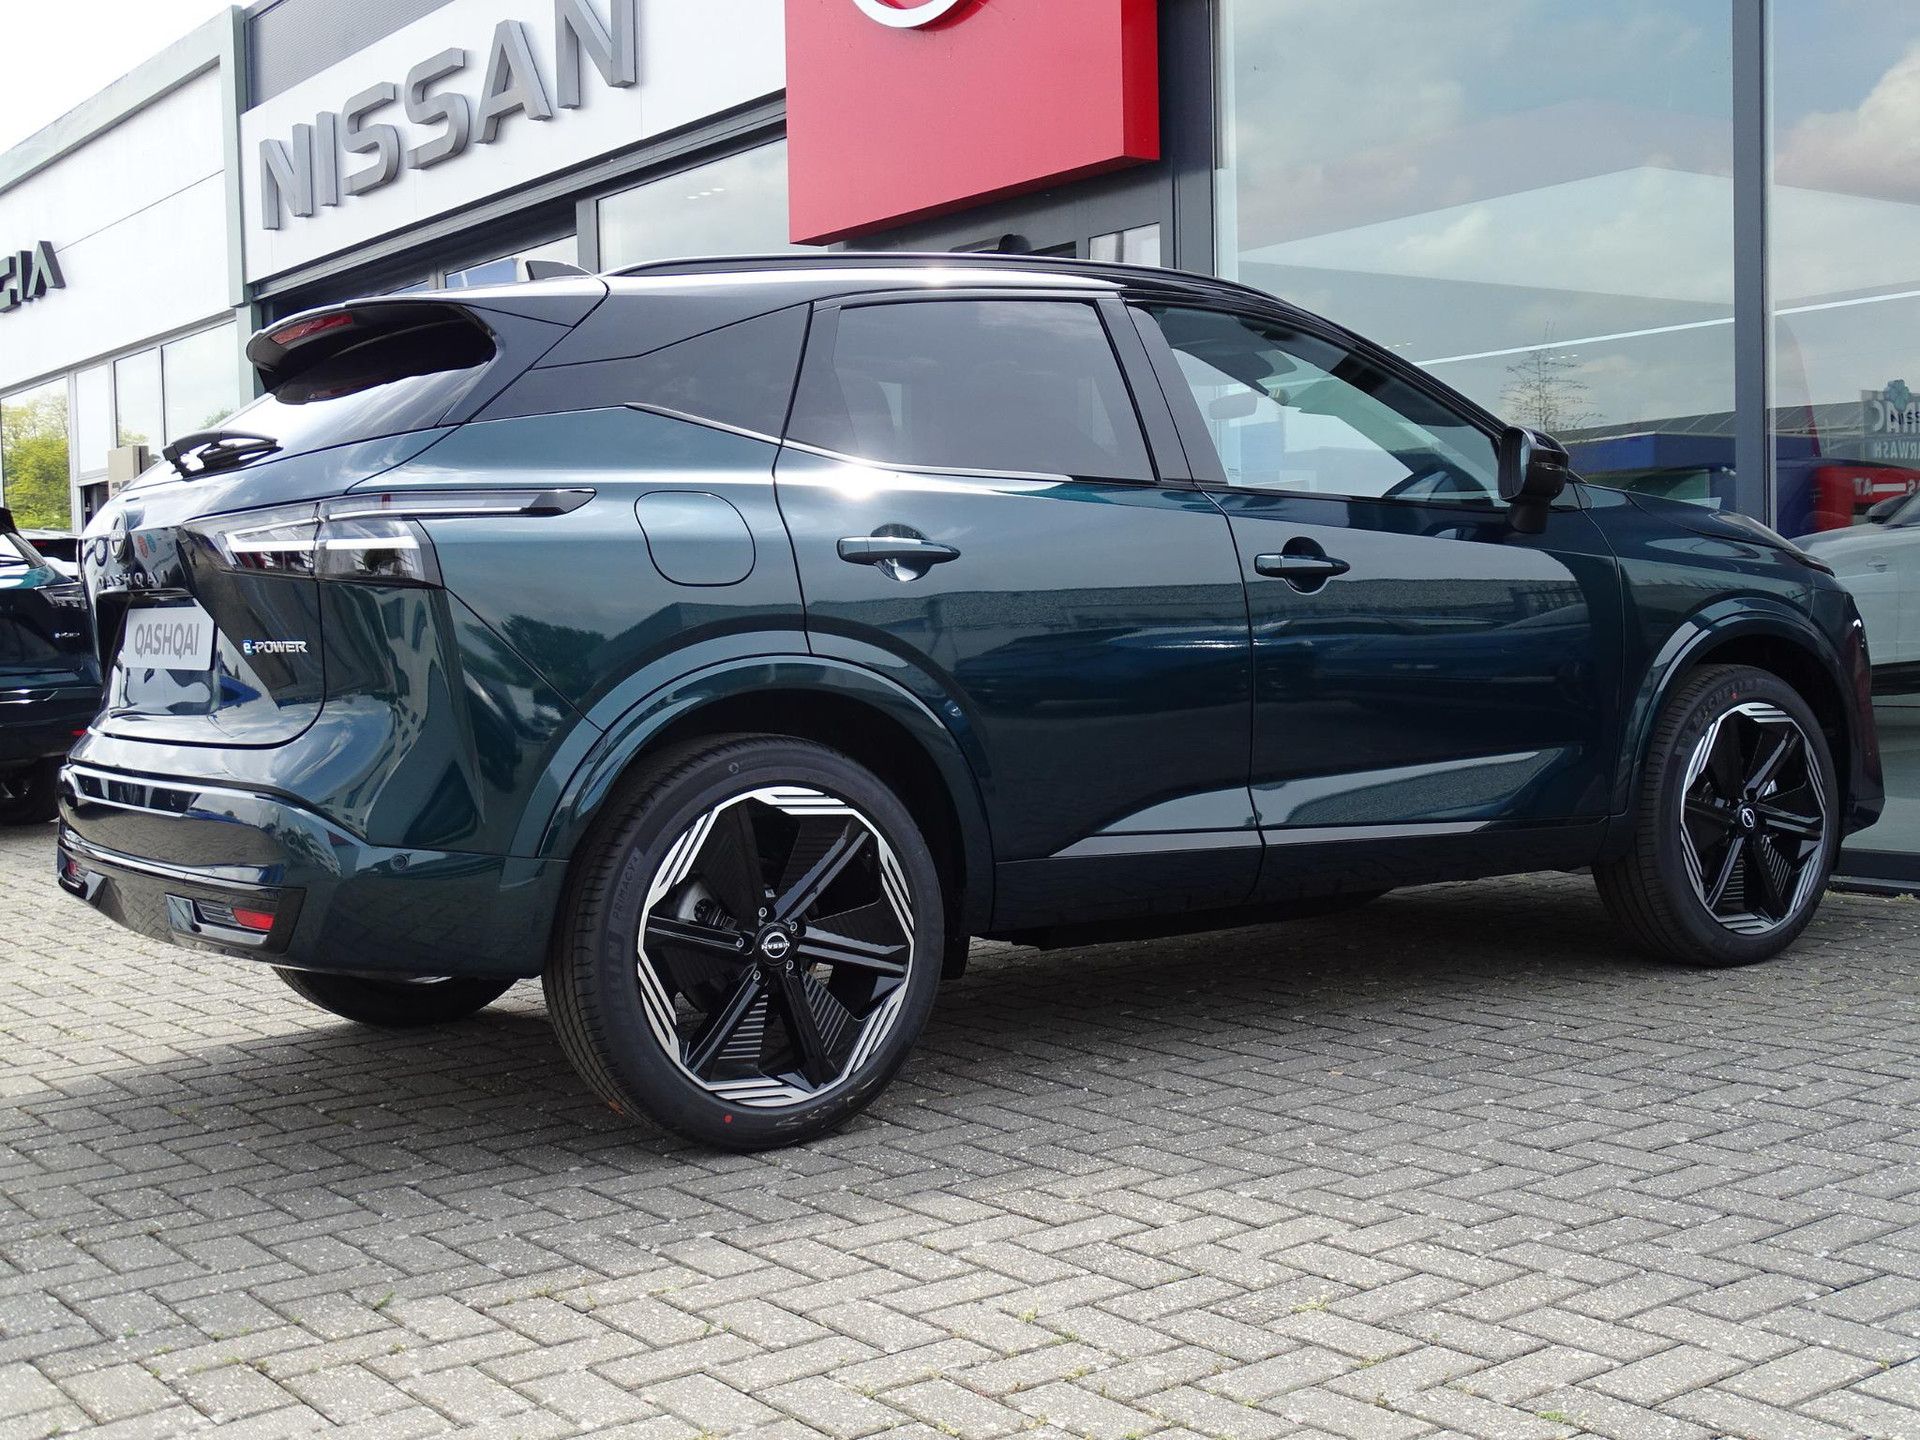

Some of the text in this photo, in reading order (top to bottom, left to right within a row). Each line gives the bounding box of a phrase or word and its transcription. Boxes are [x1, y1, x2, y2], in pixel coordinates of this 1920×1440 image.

[259, 0, 638, 230] NISSAN
[135, 623, 199, 659] QASHQAI
[243, 639, 308, 653] e-POWER
